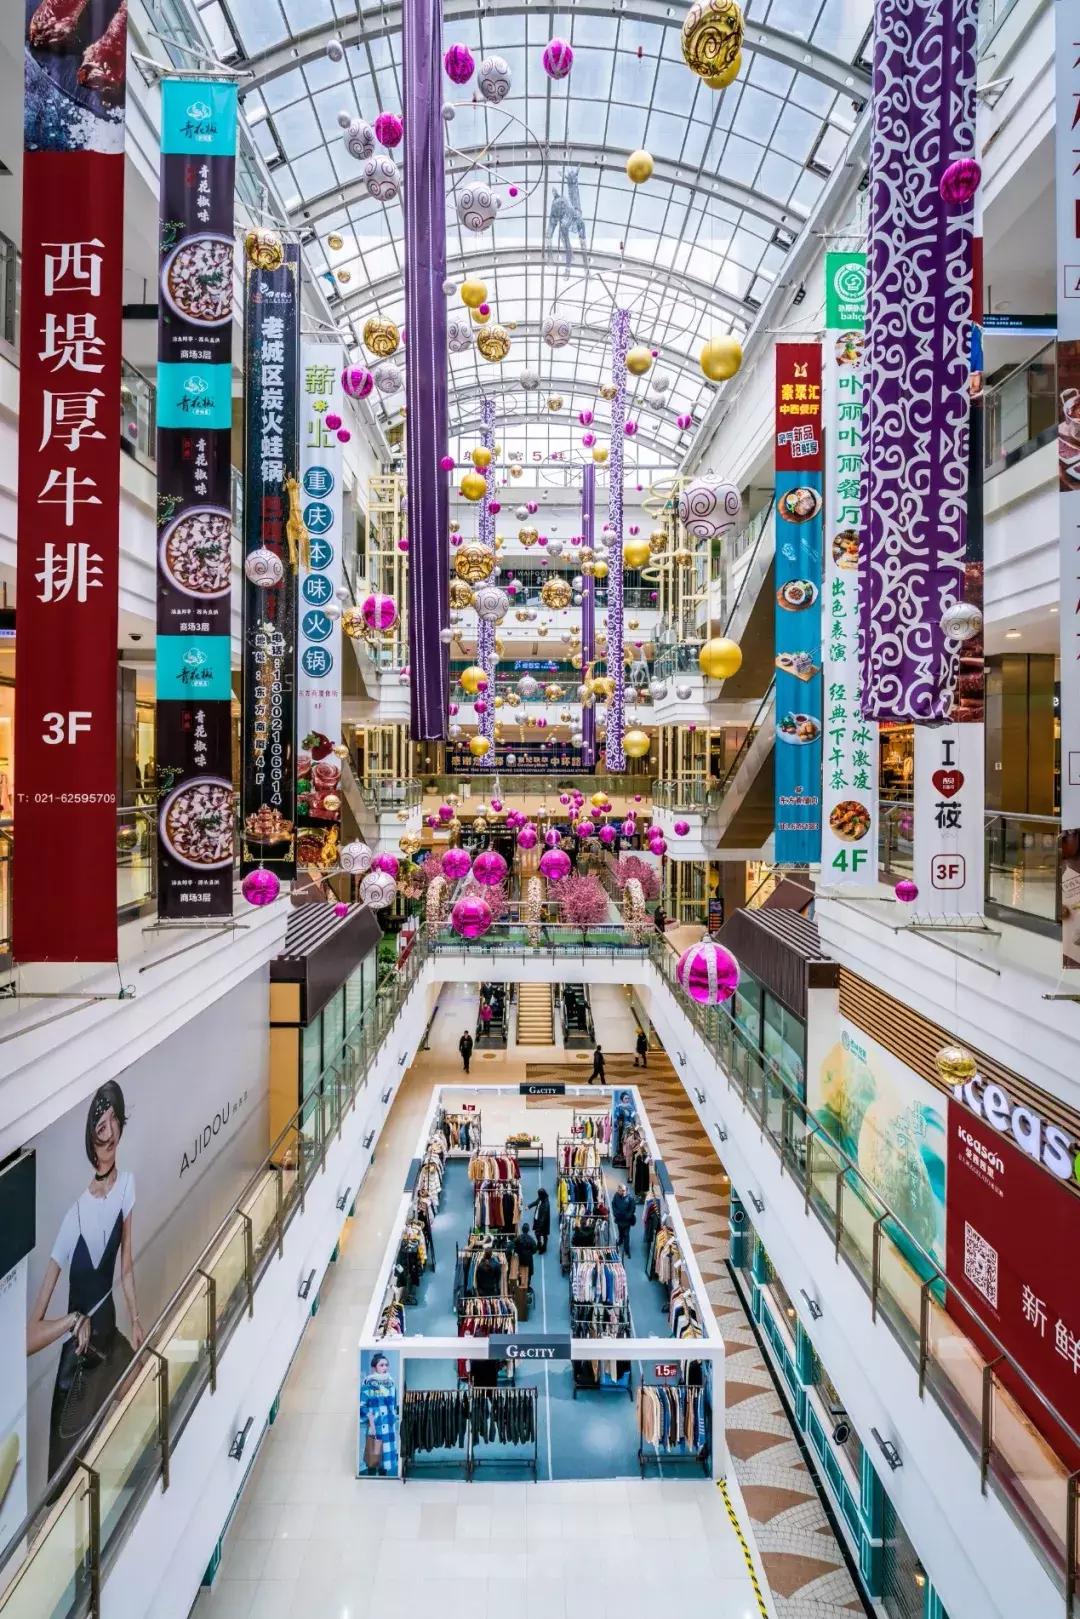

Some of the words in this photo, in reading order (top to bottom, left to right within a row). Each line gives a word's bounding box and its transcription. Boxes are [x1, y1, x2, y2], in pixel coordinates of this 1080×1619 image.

[197, 164, 211, 222] 青花椒味
[180, 350, 212, 360] 商场3层
[261, 316, 284, 482] 老城区炭火蛙锅
[779, 404, 820, 415] 中西餐厅
[34, 237, 107, 603] 西堤厚牛排
[194, 438, 208, 496] 青花椒味
[306, 471, 328, 671] 重庆本味火锅
[179, 622, 210, 632] 商场3层
[830, 577, 848, 662] 出色表演
[42, 711, 93, 744] 3F
[194, 710, 208, 767] 青花椒味
[828, 683, 849, 790] 经典下午茶
[942, 740, 955, 766] I
[34, 793, 115, 804] 021-62595709
[832, 849, 868, 872] 4F
[937, 864, 959, 880] 3F
[180, 893, 211, 902] 商场3层
[179, 1102, 230, 1178] AJIDOU
[506, 1345, 555, 1358] G&CITY
